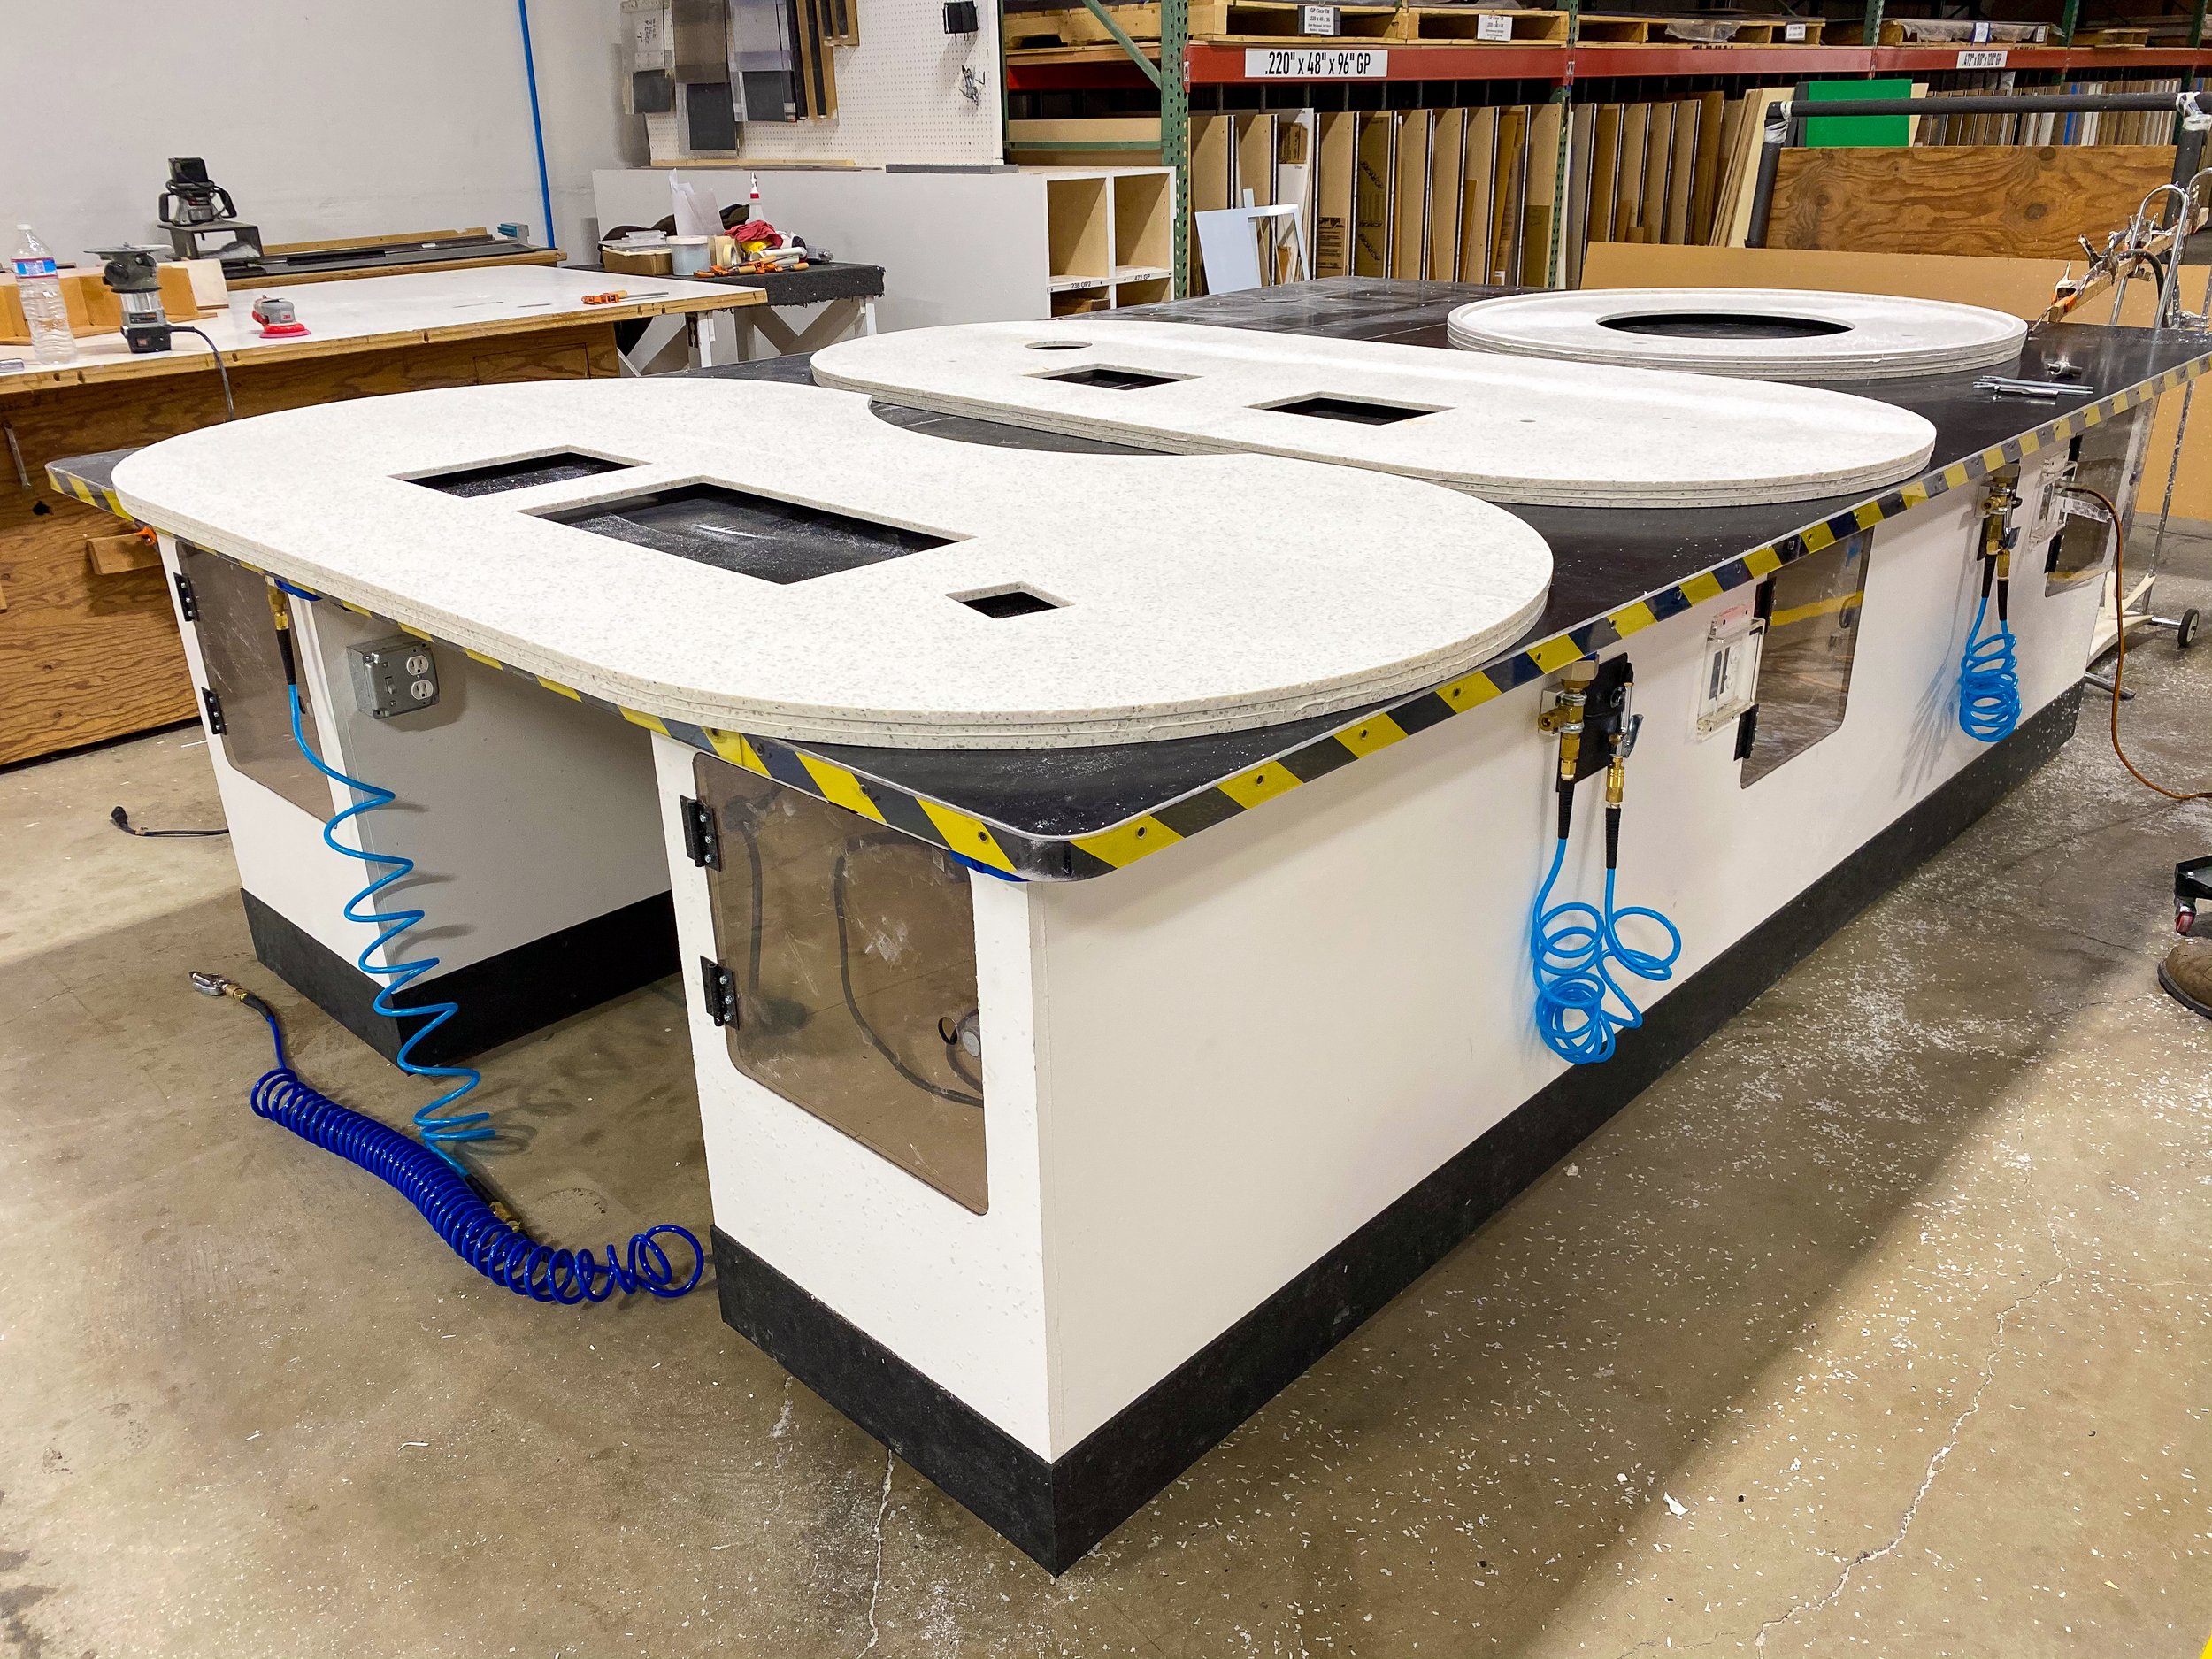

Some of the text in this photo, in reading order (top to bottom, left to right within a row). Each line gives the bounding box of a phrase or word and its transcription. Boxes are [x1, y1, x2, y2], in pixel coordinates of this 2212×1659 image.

[1265, 51, 1371, 75] .220" x 48" x 96" GP
